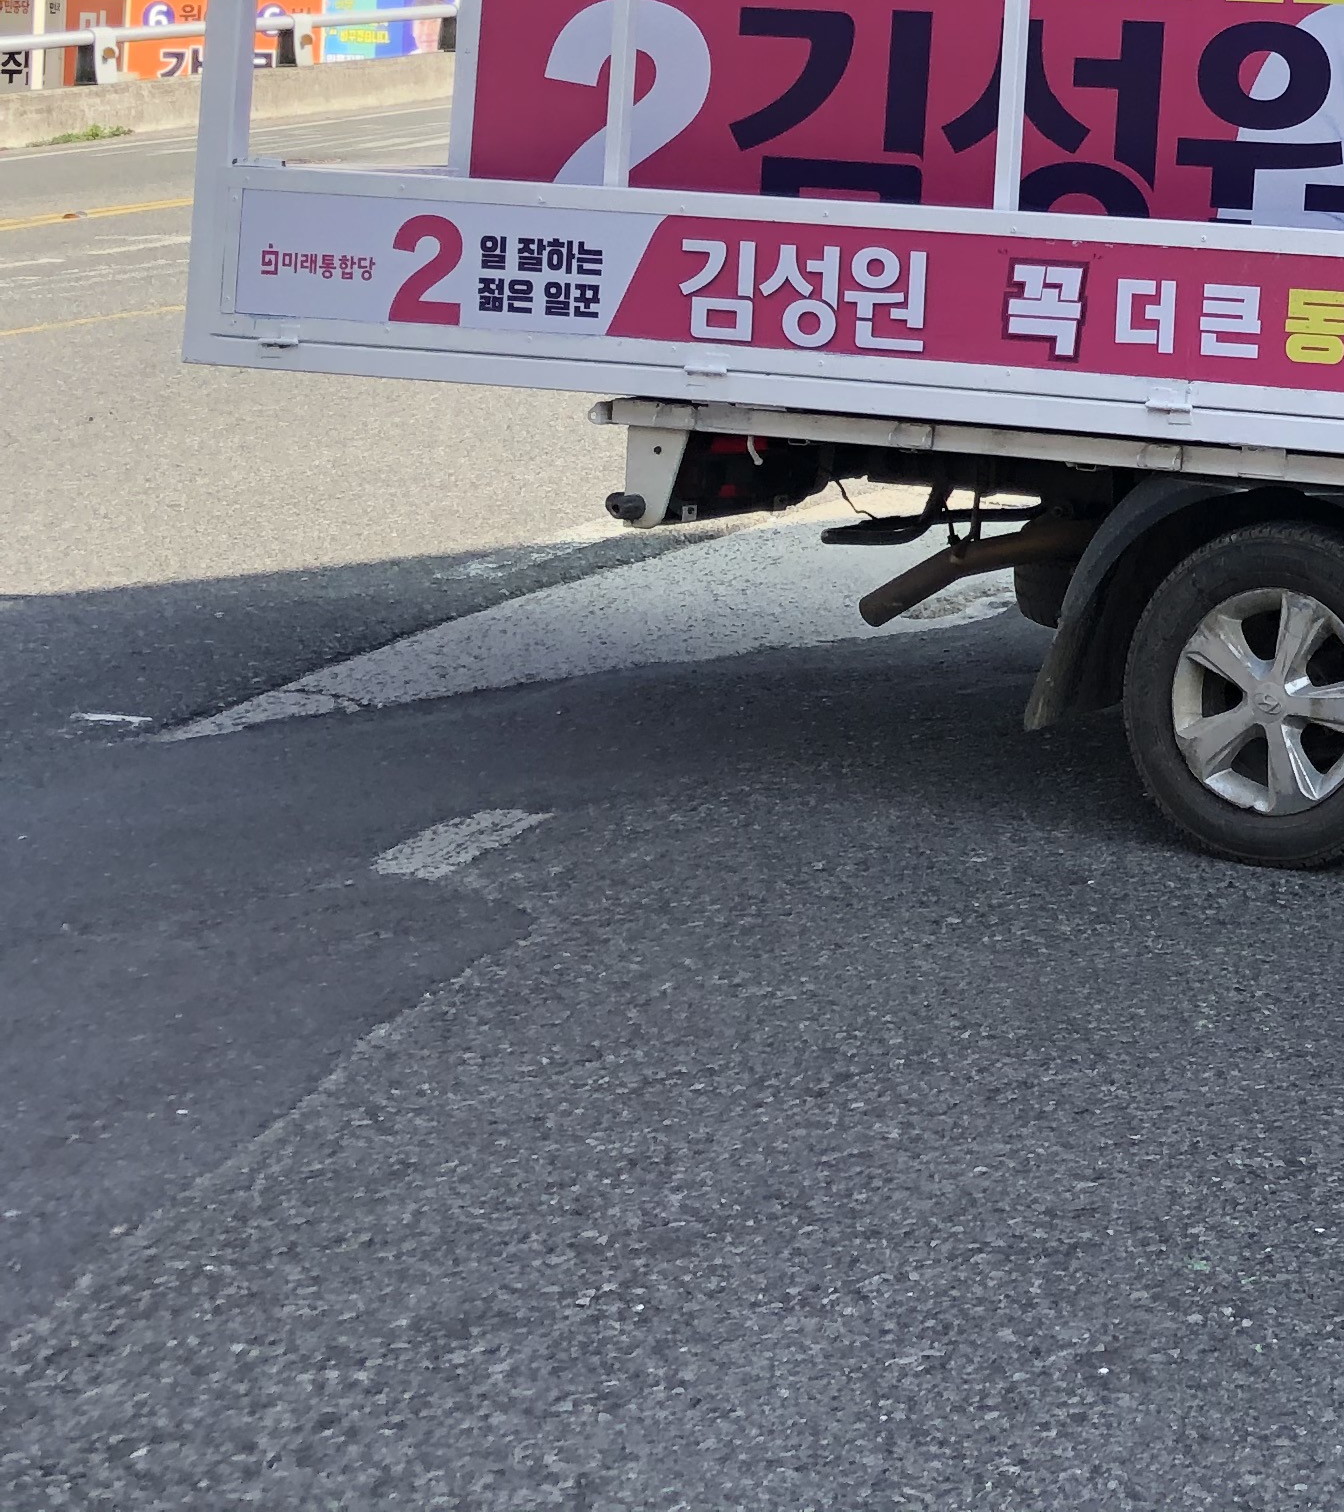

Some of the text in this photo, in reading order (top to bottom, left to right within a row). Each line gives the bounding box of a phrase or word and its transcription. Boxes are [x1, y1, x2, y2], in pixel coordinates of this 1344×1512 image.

[281, 249, 376, 281] 미래통합당
[388, 213, 465, 326] 2
[478, 234, 604, 275] 일 잘하는
[477, 277, 602, 319] 젊은 일꾼
[678, 236, 929, 355] 김성원
[1005, 260, 1086, 360] 꼭
[1113, 275, 1178, 356] 더
[1199, 281, 1263, 361] 큰
